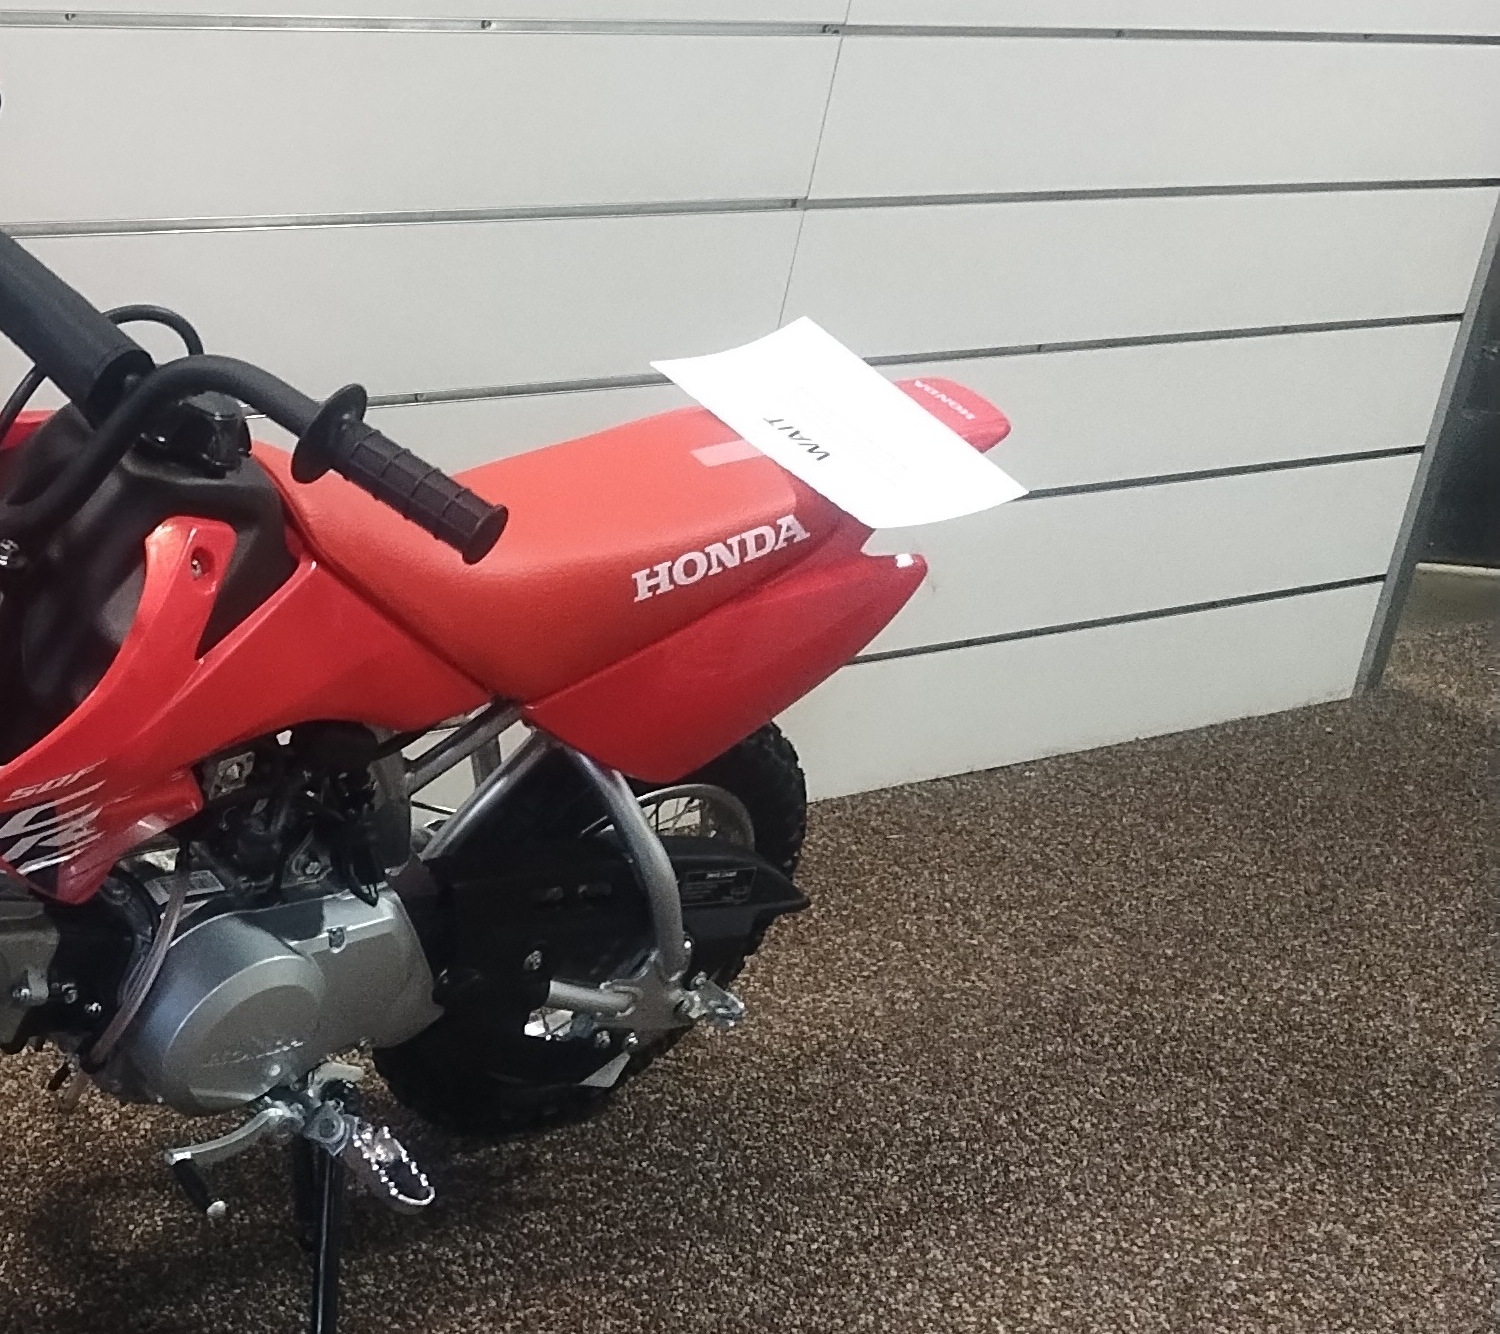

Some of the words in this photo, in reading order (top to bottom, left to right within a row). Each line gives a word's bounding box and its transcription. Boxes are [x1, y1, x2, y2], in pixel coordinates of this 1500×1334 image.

[914, 381, 975, 419] HONDA
[763, 417, 830, 461] WAIT
[631, 514, 810, 601] HONDA
